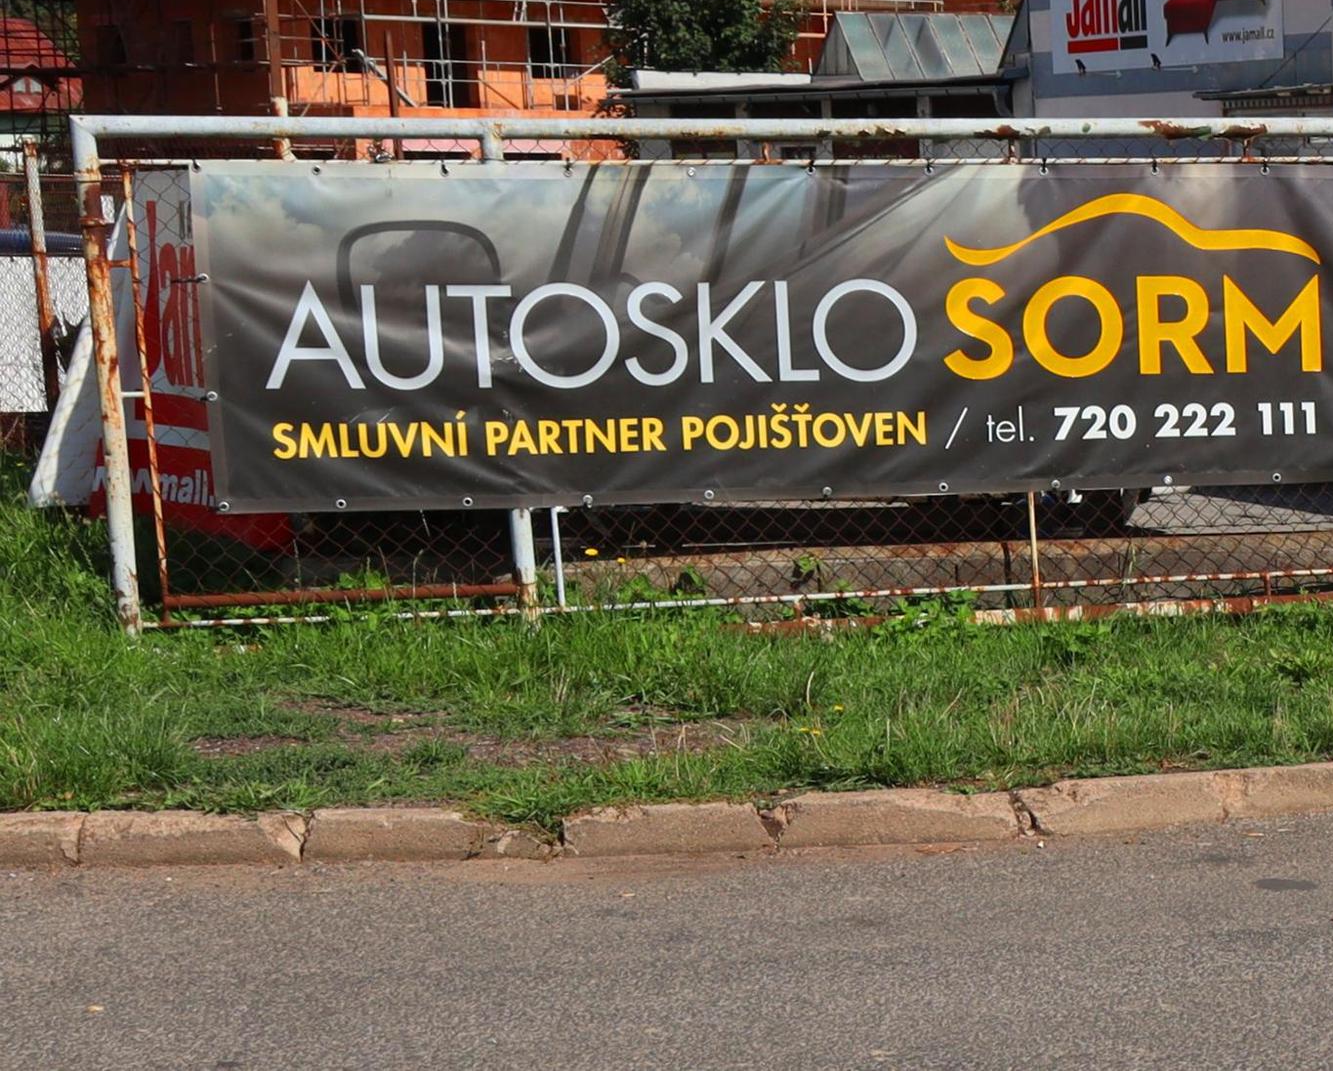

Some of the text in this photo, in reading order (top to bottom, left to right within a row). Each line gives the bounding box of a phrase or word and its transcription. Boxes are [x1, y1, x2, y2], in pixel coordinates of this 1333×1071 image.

[1222, 27, 1275, 44] www.jamall.cz
[265, 278, 918, 391] AUTOSKLO
[272, 410, 470, 460] SMLUVNÍ
[485, 416, 667, 457] PARTNER
[682, 402, 928, 452] POJIŠŤOVEN
[986, 405, 1035, 443] tel.
[1053, 404, 1137, 441] 720
[1154, 402, 1237, 438] 222
[1257, 401, 1317, 436] 111
